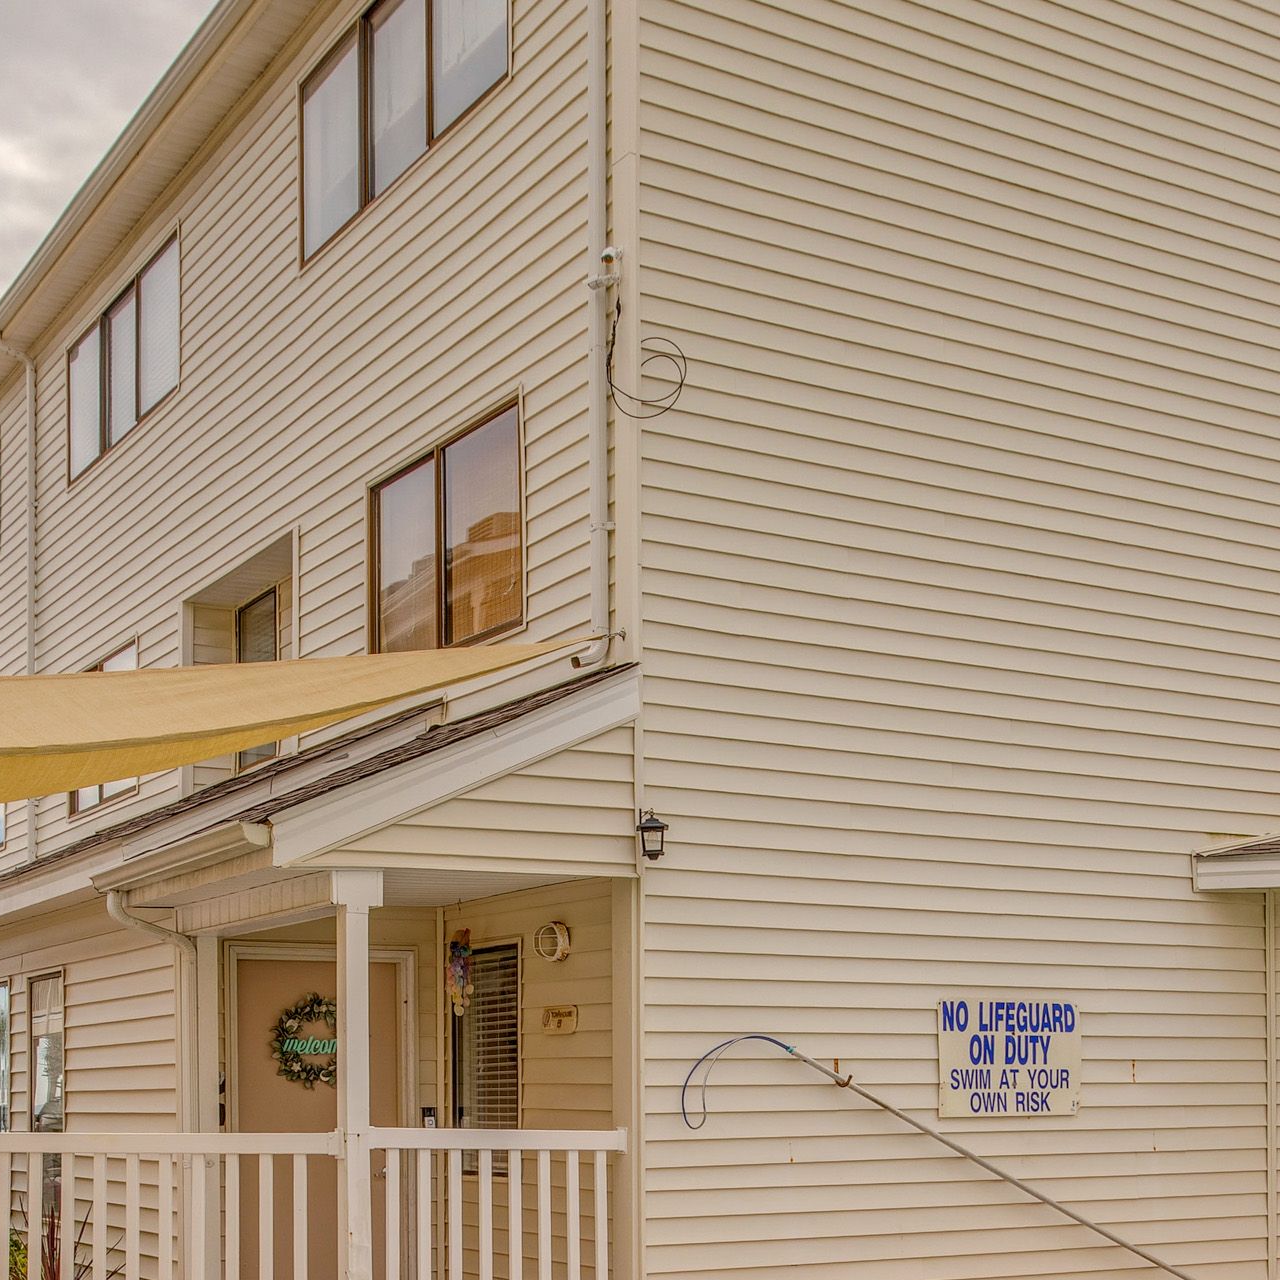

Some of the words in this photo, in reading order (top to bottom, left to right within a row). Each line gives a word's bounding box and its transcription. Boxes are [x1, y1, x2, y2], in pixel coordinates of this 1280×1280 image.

[943, 1001, 969, 1031] NO
[979, 1002, 1075, 1032] LIFEGUARD
[970, 1034, 994, 1065] ON
[1005, 1035, 1051, 1065] DUTY
[950, 1069, 991, 1090] SWIM
[999, 1069, 1019, 1089] AT
[1027, 1069, 1069, 1089] YOUR
[970, 1092, 1007, 1113] OWN
[1015, 1092, 1051, 1112] RISK
